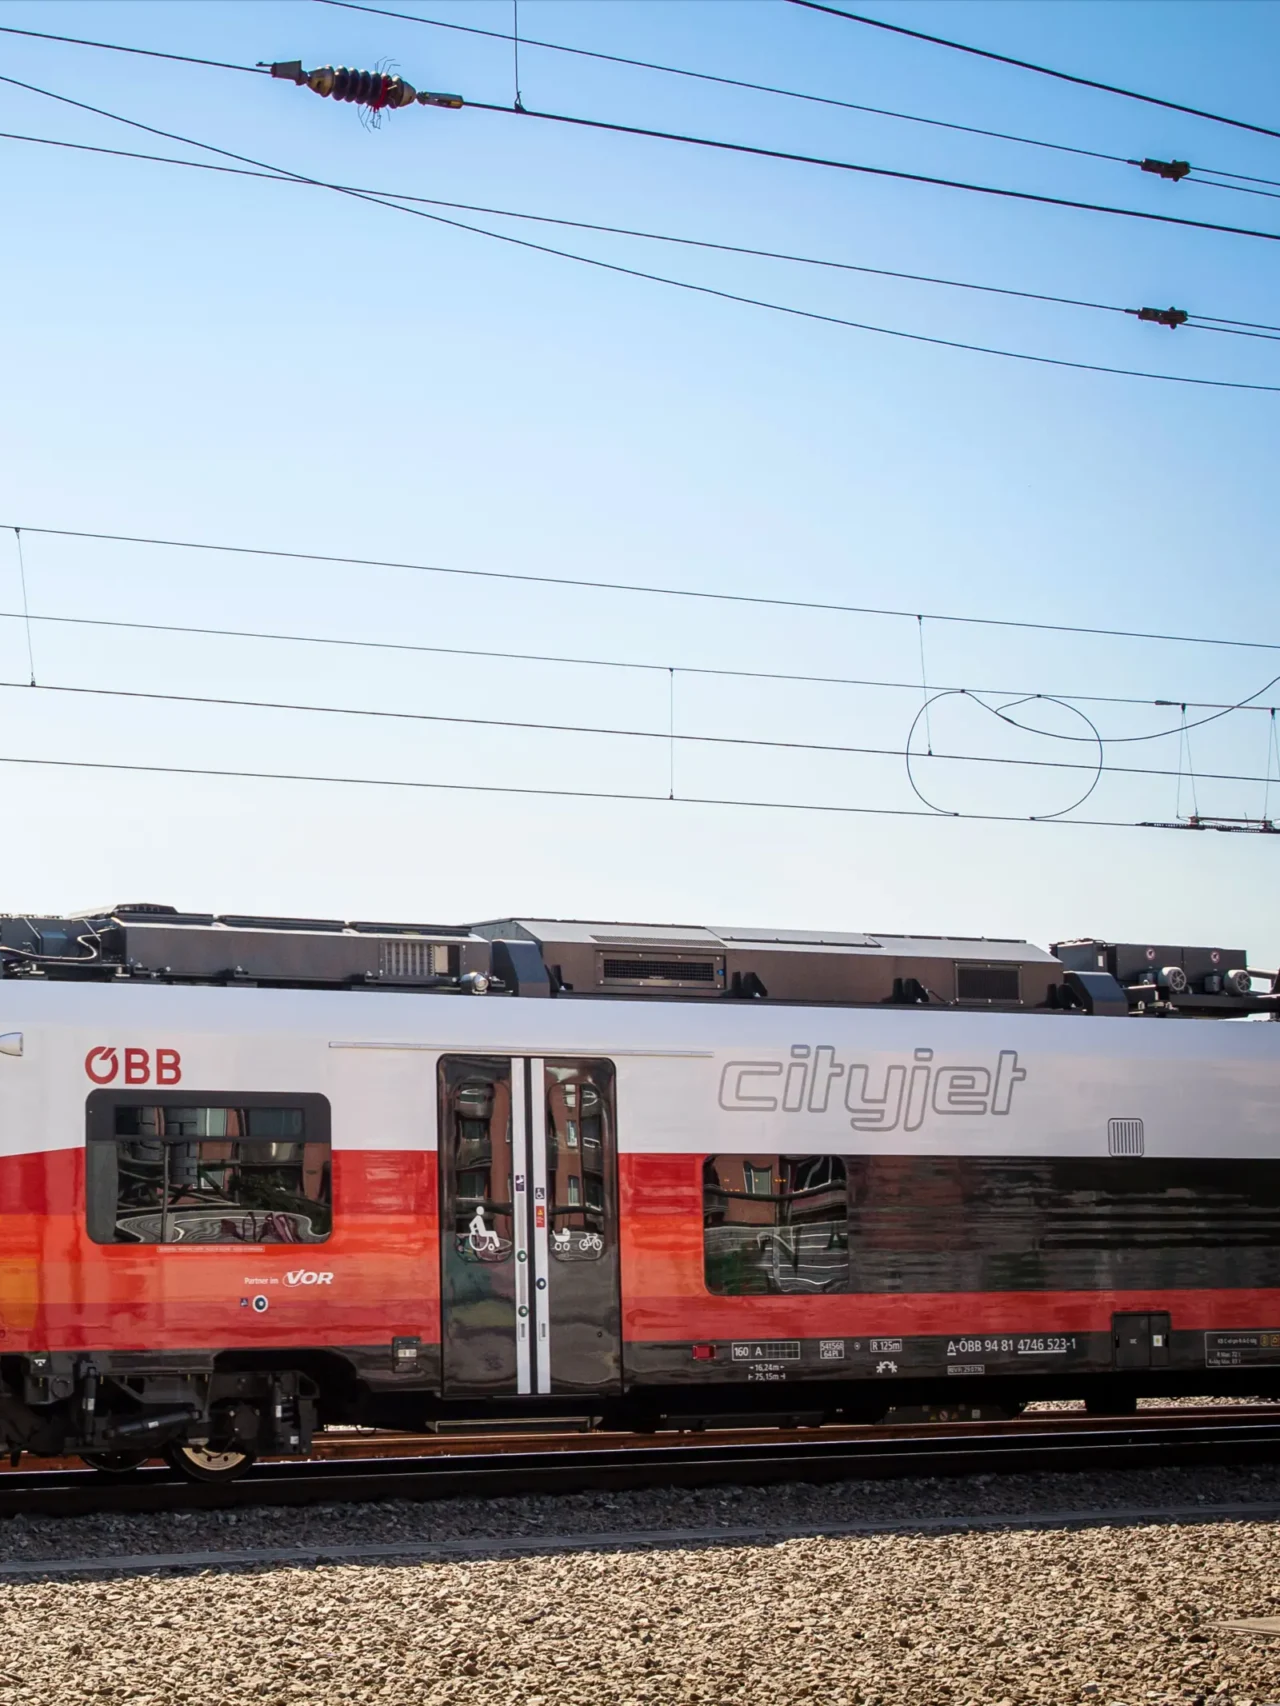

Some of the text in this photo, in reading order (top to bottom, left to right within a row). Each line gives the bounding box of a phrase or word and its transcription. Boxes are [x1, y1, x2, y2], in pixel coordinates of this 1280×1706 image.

[85, 1046, 182, 1085] ÖBB
[718, 1044, 1027, 1132] cityjet
[244, 1277, 268, 1285] Partner
[283, 1269, 334, 1287] VOR
[734, 1346, 763, 1357] 160 A
[872, 1341, 900, 1351] R 125m
[947, 1337, 1076, 1353] A-ÖBB 94 81 4746 523-1
